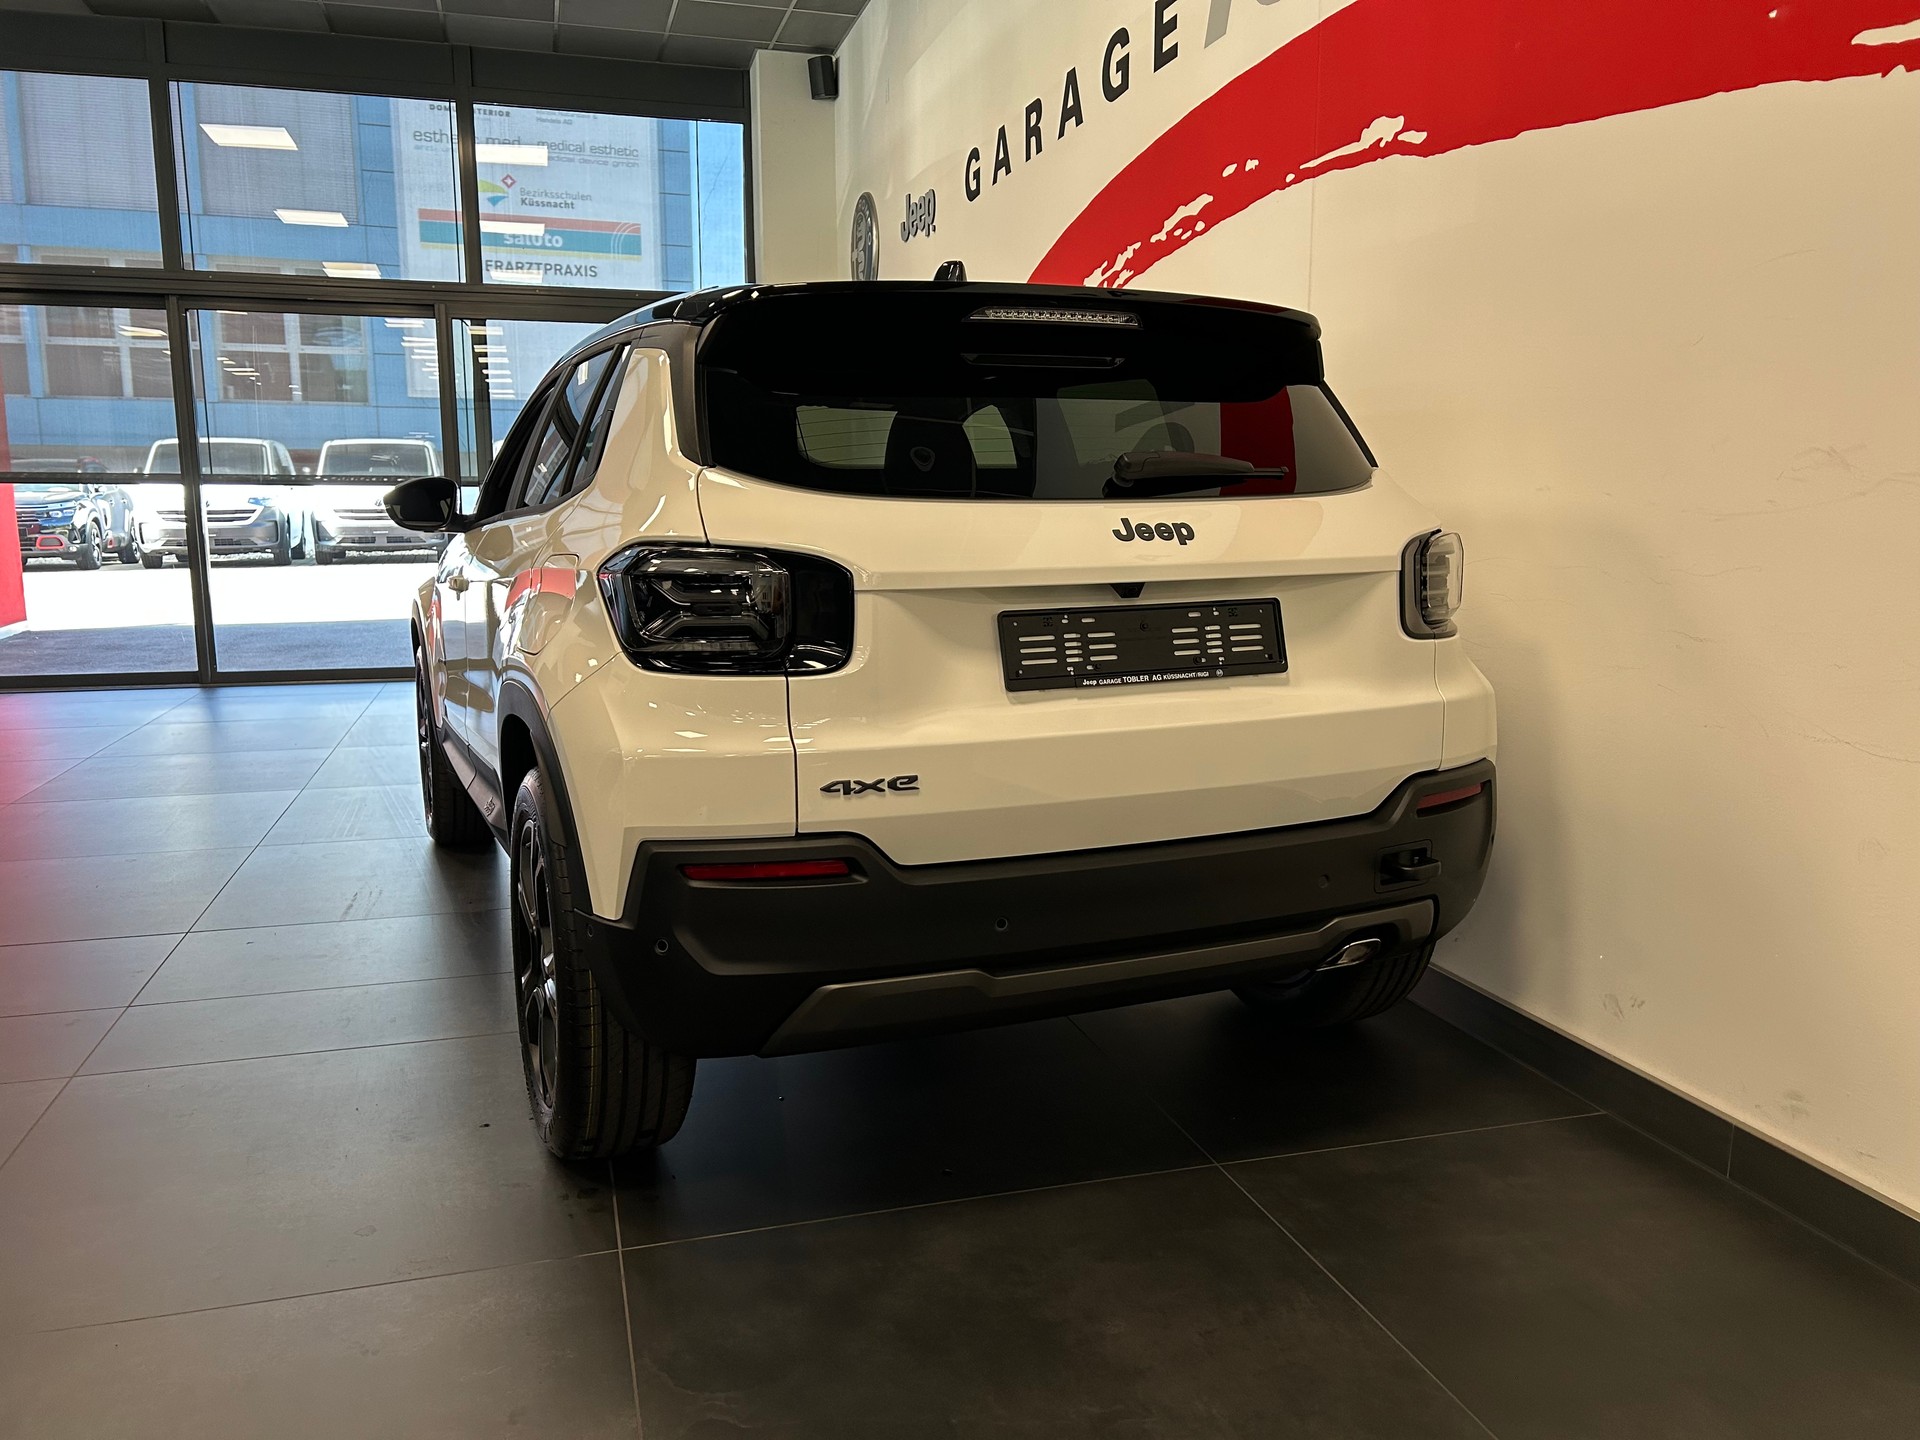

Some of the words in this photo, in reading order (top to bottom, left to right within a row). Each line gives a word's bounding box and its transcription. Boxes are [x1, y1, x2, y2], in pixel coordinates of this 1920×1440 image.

[964, 0, 1179, 202] GARAGE
[589, 143, 640, 158] esthetic
[519, 187, 592, 201] Bezirksschulen
[520, 197, 576, 210] Küssnacht
[901, 189, 936, 243] Jeep
[503, 232, 563, 247] saluto
[1112, 517, 1195, 545] Jeep
[1098, 677, 1122, 685] GARAGE
[1122, 675, 1150, 683] TOBLER
